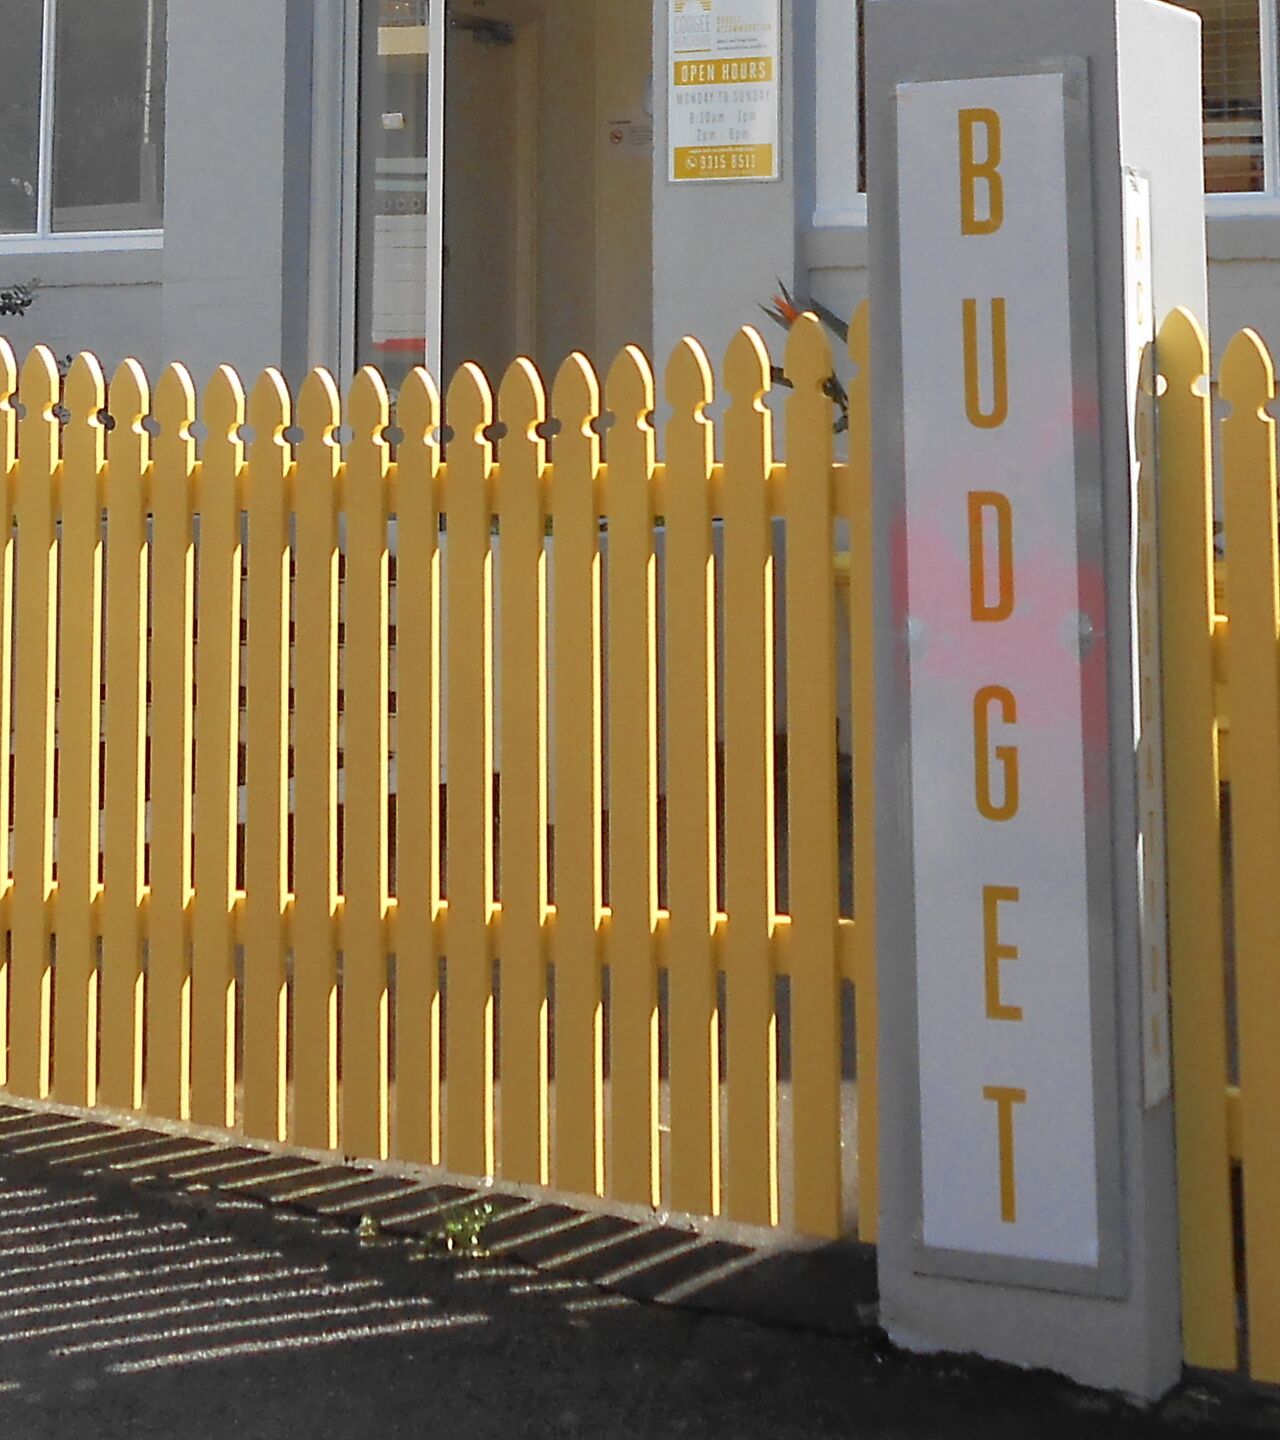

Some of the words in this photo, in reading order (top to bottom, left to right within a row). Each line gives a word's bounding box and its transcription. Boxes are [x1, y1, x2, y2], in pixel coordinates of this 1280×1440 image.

[673, 15, 711, 34] COOGEE
[681, 63, 715, 82] OPEN
[722, 61, 766, 80] HOURS
[676, 91, 714, 105] MONDAY
[717, 90, 729, 103] TO
[733, 89, 769, 103] SUNDAY
[956, 106, 1027, 1225] BUDGET
